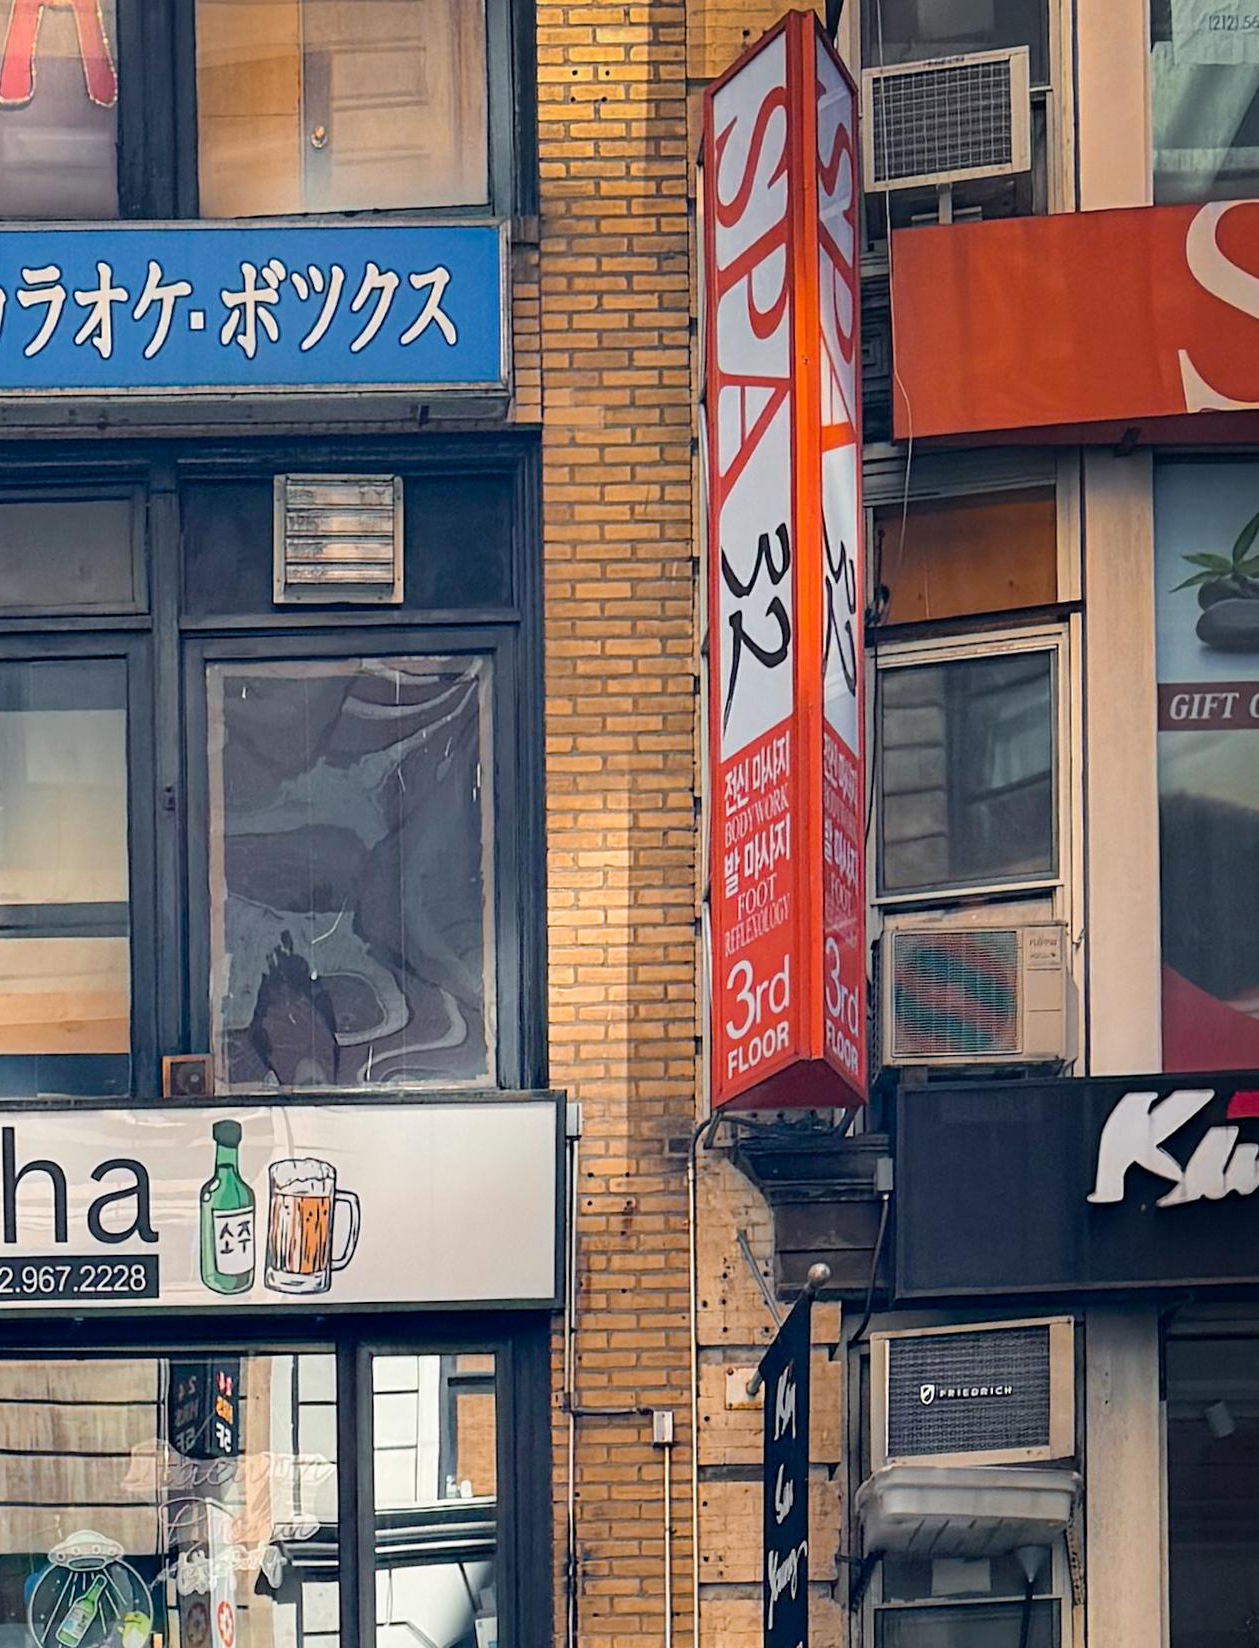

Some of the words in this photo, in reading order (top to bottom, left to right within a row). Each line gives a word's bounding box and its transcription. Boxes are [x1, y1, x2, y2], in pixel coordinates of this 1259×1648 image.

[1169, 694, 1238, 721] GIFT
[737, 872, 778, 922] FOOT
[726, 953, 791, 1041] 3rd
[727, 1019, 791, 1080] FLOOR
[938, 1384, 1014, 1400] FRIEDRICH
